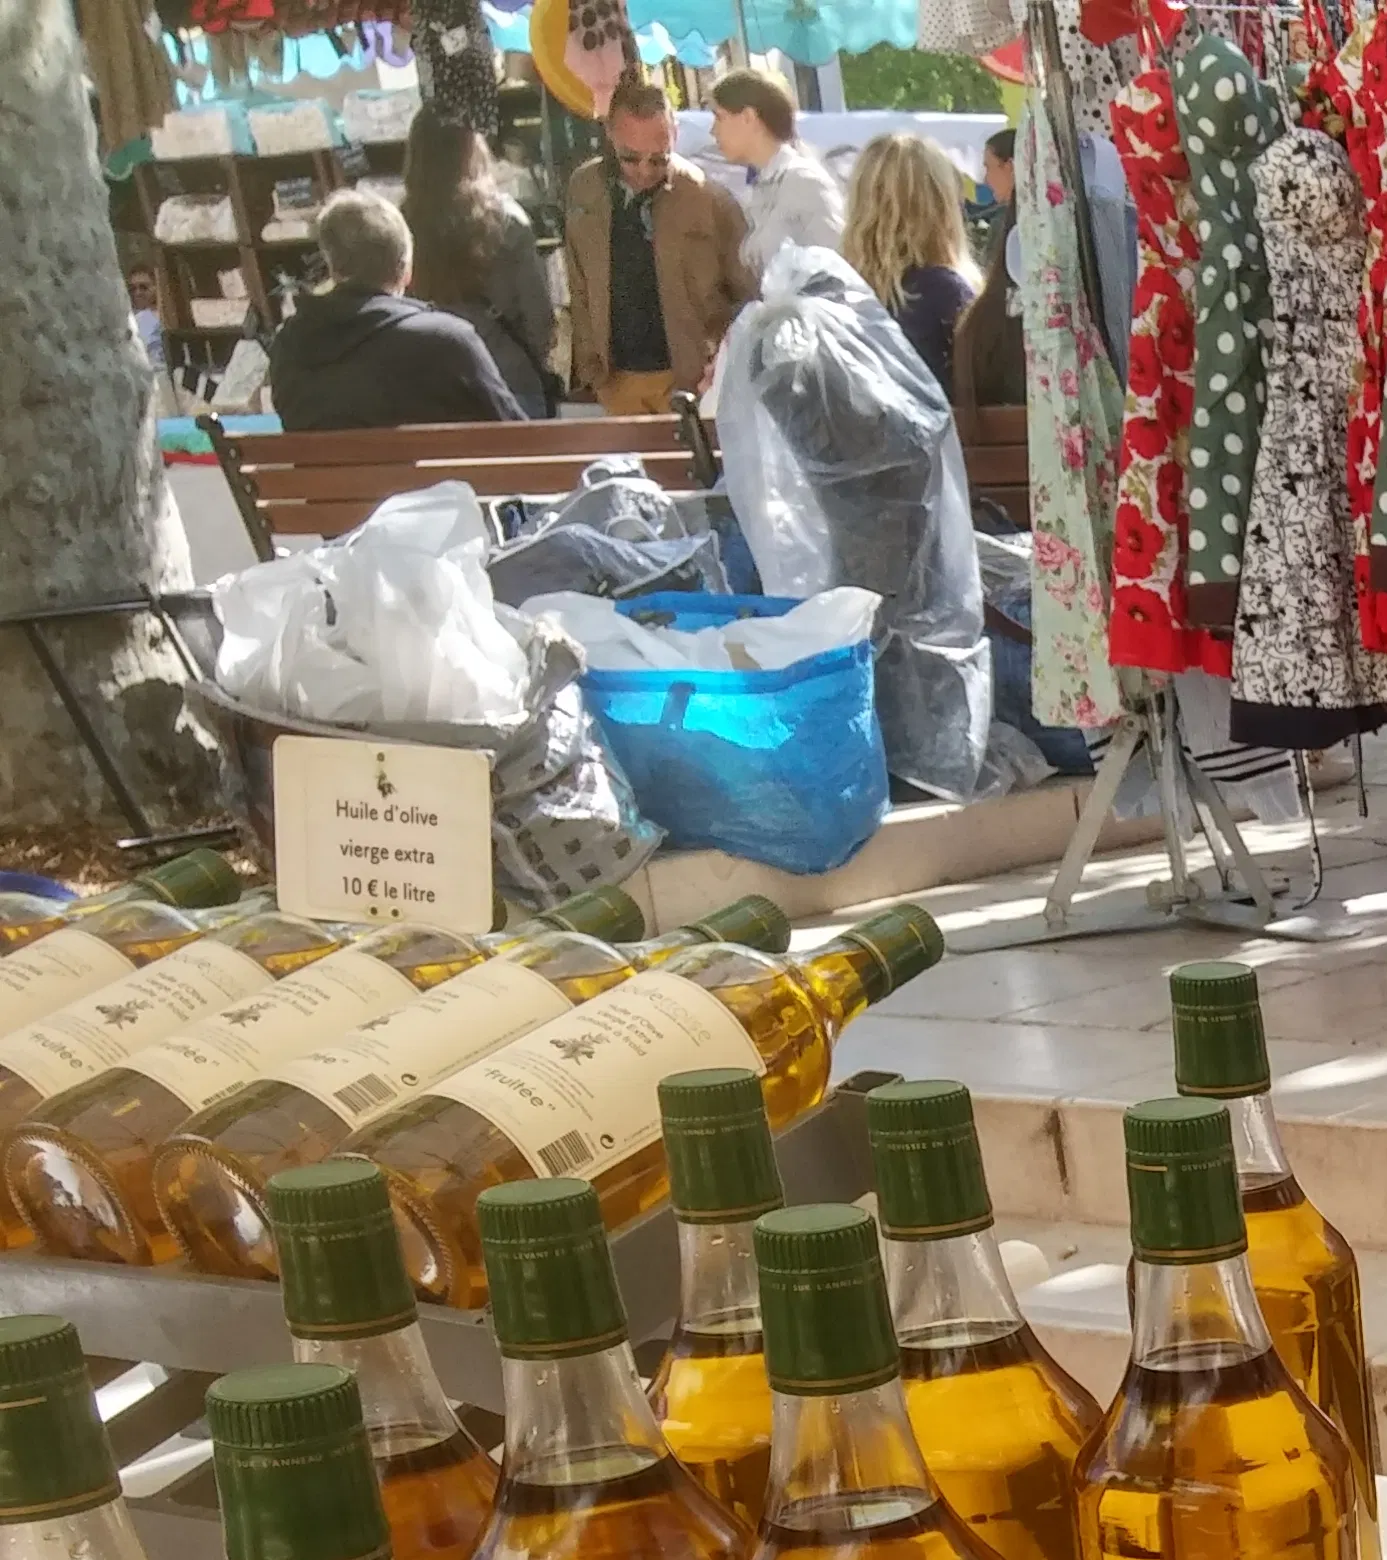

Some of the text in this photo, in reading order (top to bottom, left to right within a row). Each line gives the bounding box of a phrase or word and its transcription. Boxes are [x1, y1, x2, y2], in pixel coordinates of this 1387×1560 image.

[336, 799, 438, 826] Huile d'olive
[340, 839, 435, 865] vierge extra
[342, 876, 436, 903] 10 € le litre
